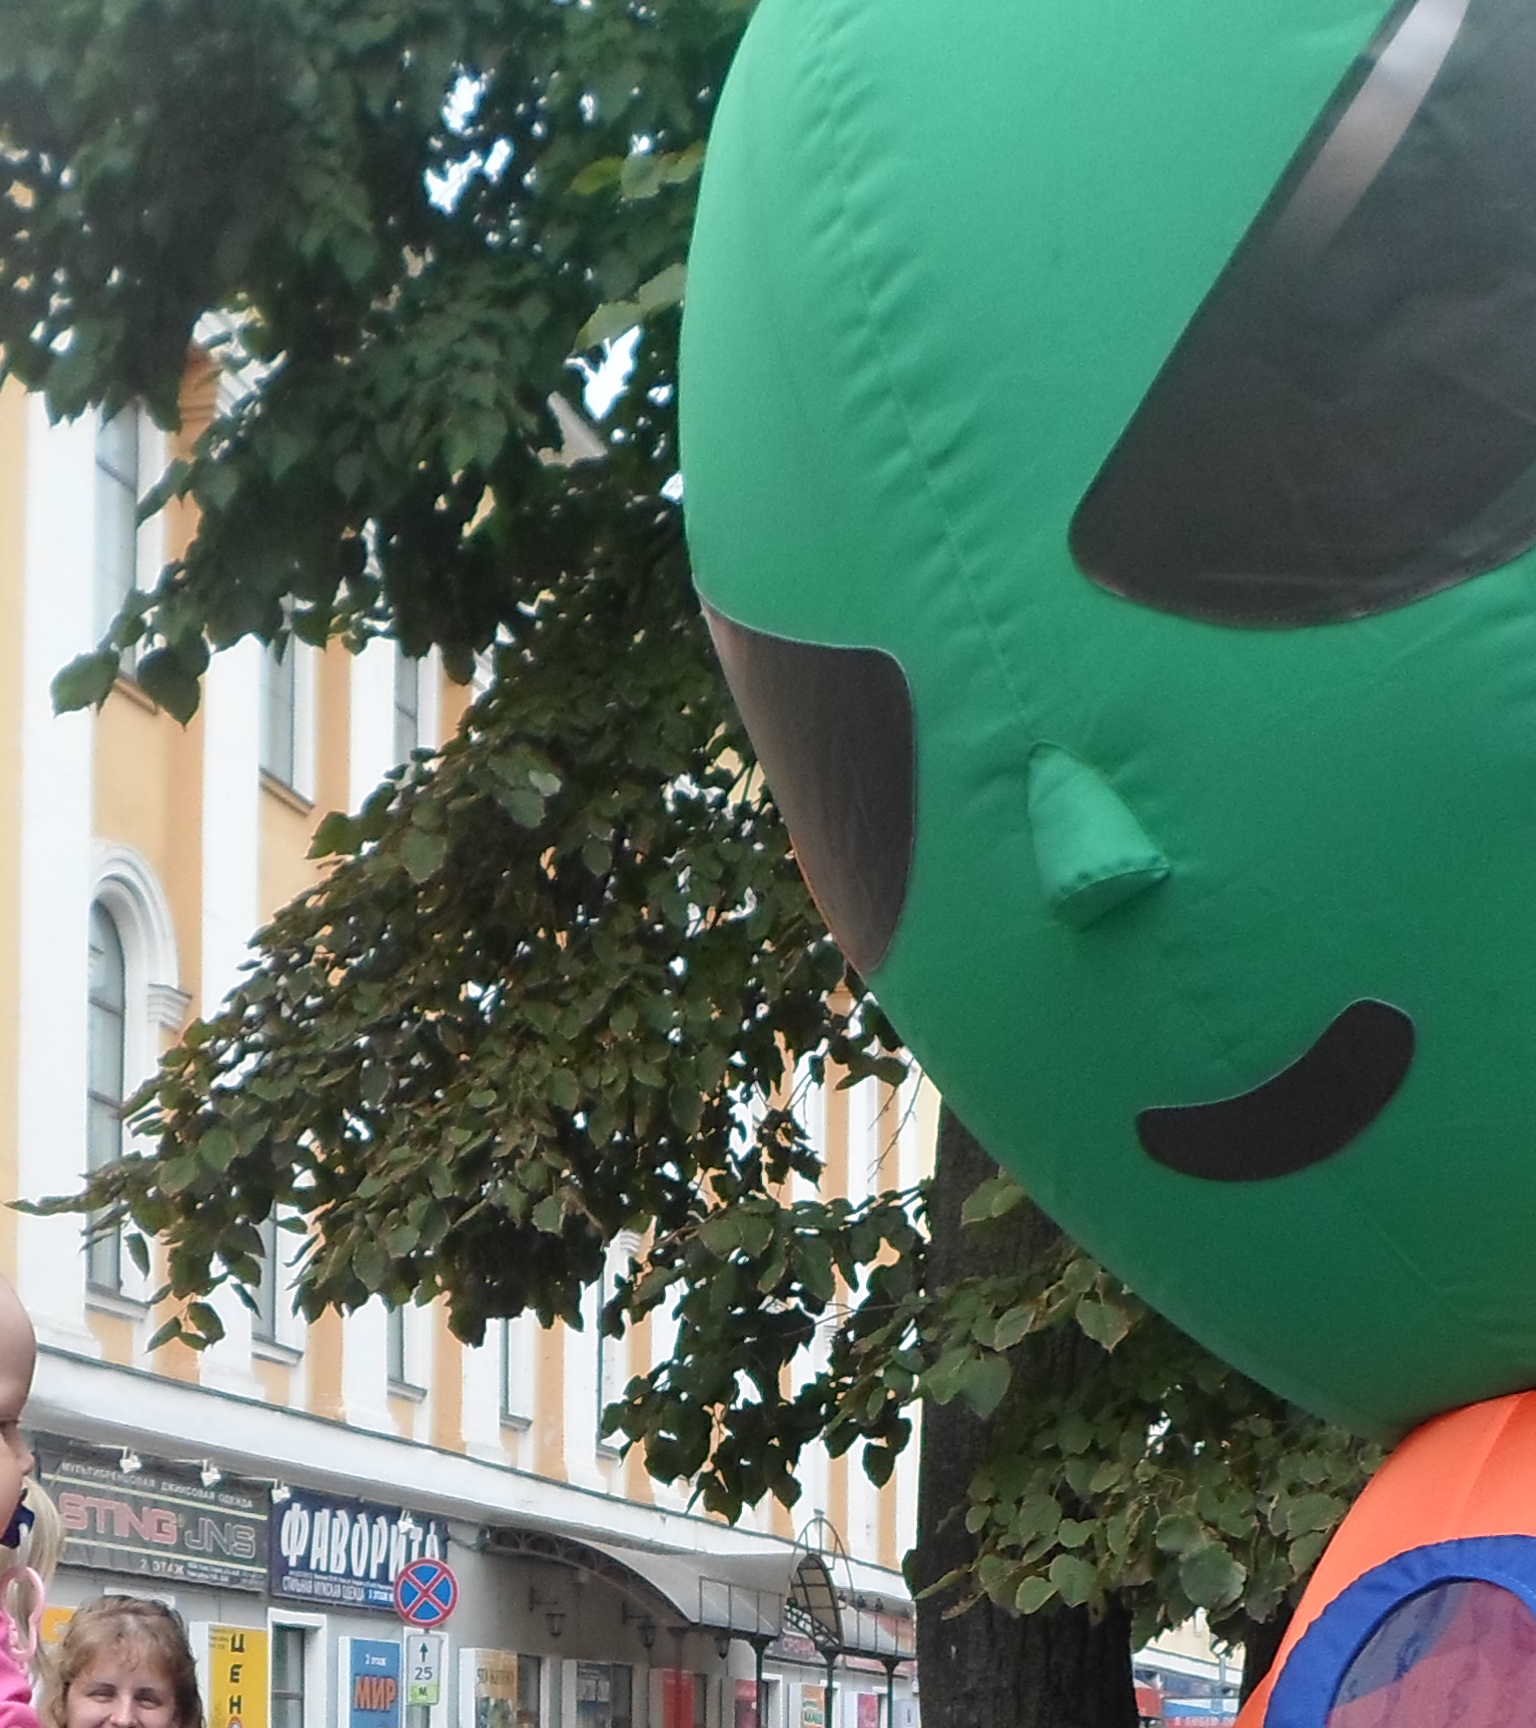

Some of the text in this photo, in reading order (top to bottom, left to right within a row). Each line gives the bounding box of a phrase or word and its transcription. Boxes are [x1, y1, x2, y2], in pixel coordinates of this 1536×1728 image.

[58, 1491, 257, 1560] STING JNS
[140, 1559, 148, 1569] 2
[152, 1559, 185, 1576] ЭТАЖ
[415, 1666, 433, 1681] 25
[354, 1675, 397, 1713] МИР
